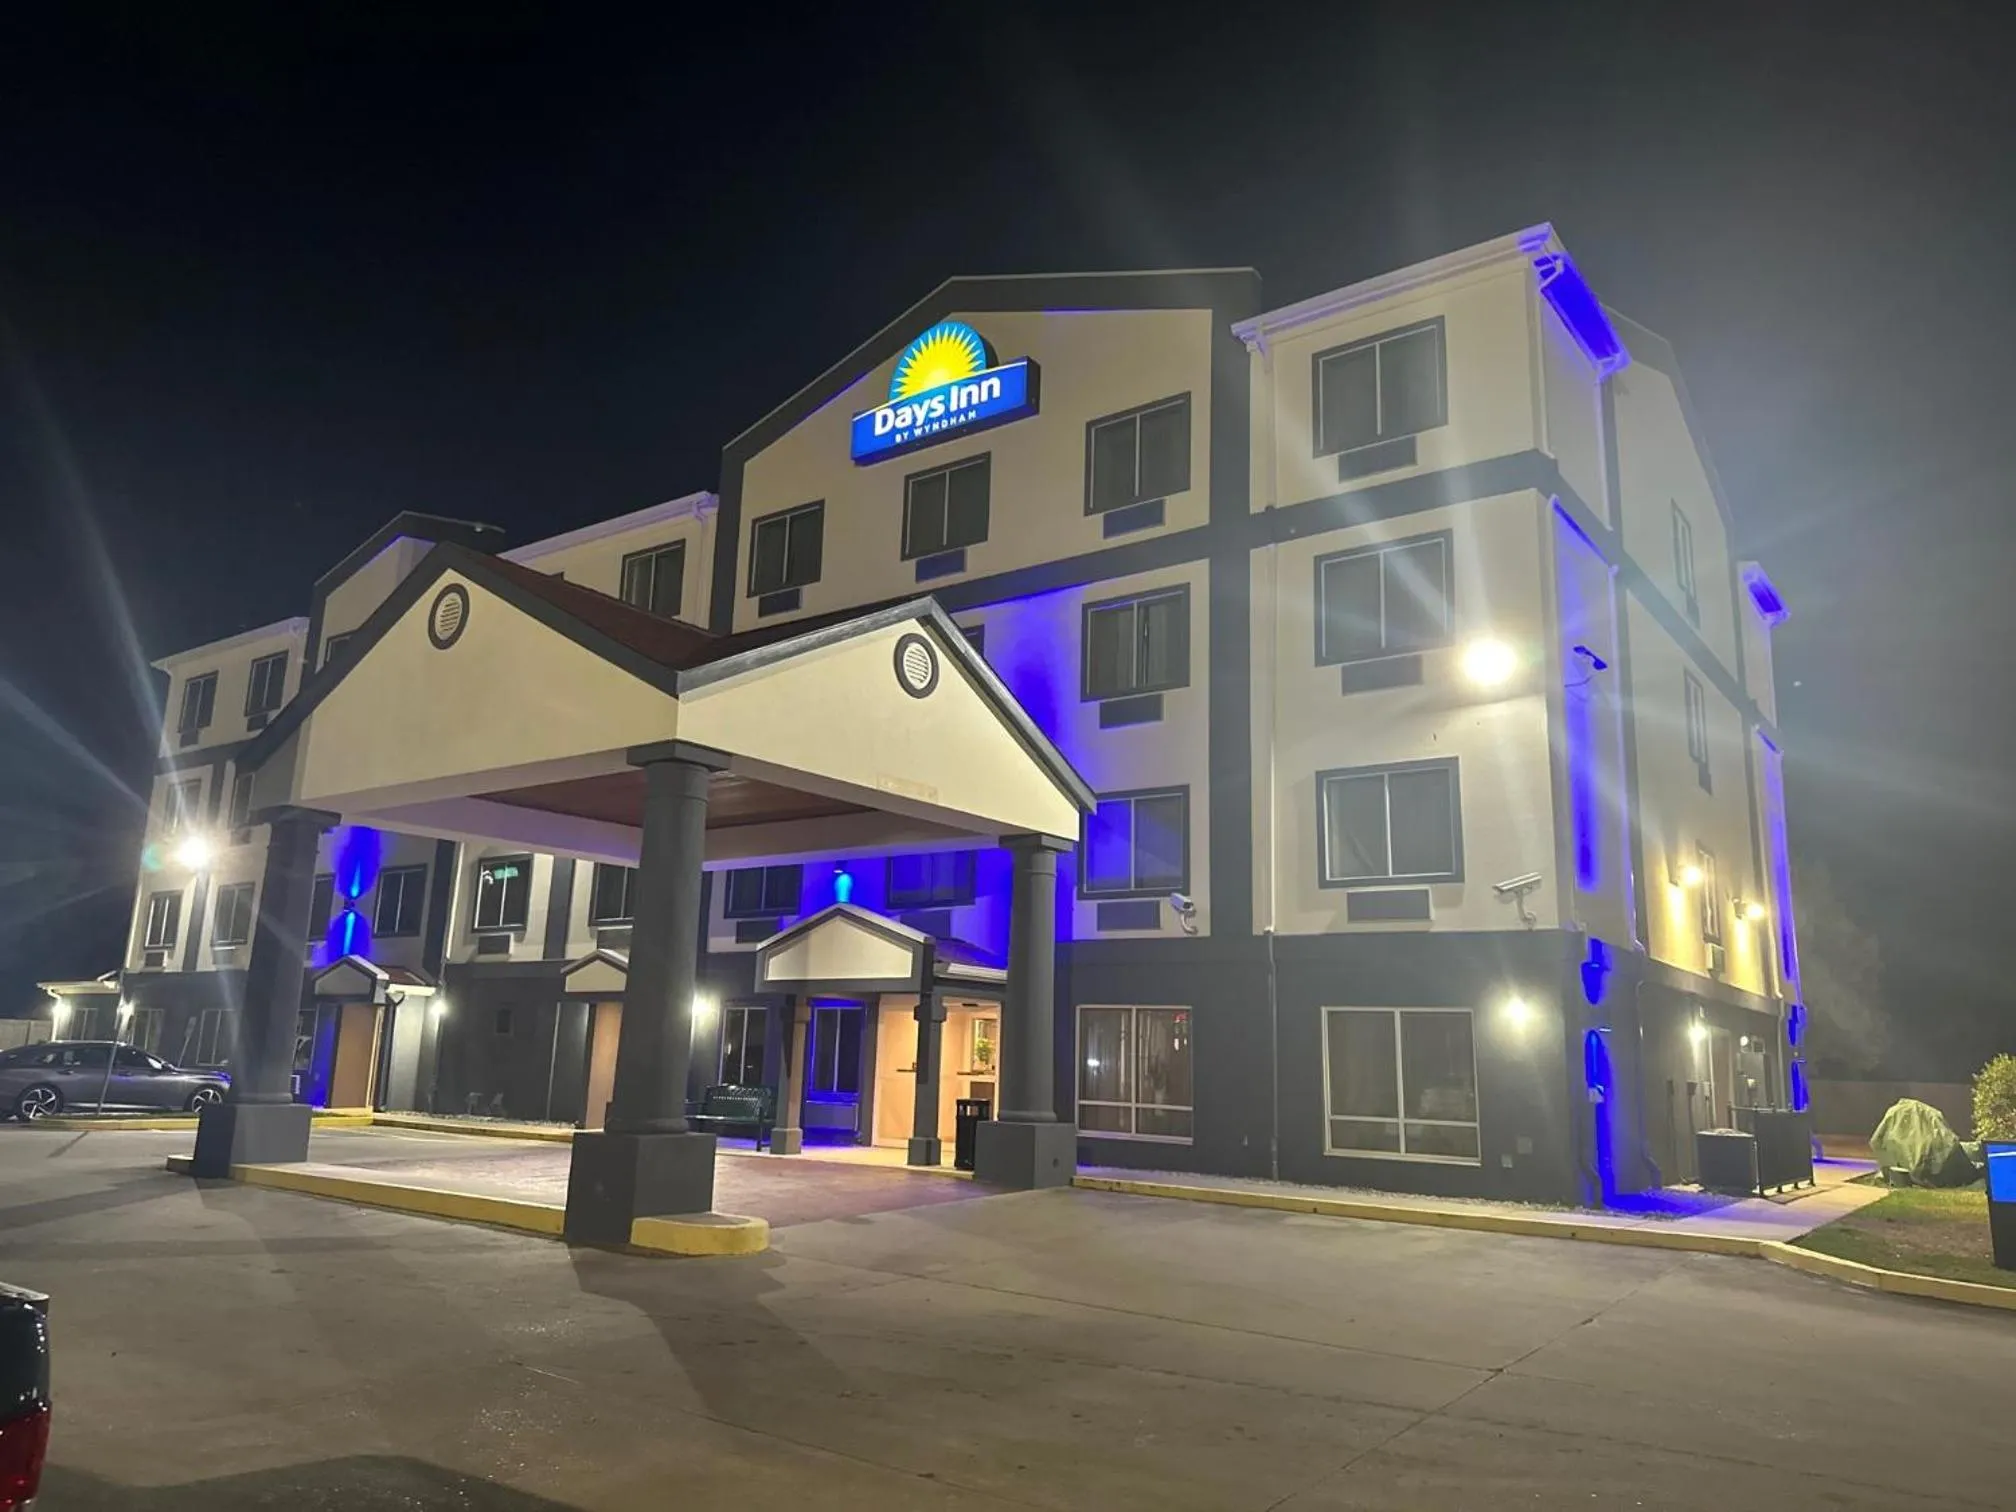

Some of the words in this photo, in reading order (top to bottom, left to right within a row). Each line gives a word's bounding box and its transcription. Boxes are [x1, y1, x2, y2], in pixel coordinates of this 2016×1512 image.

[874, 395, 946, 436] Days
[949, 376, 1001, 412] Inn
[895, 430, 910, 443] BY
[914, 410, 977, 436] WYNDHAM
